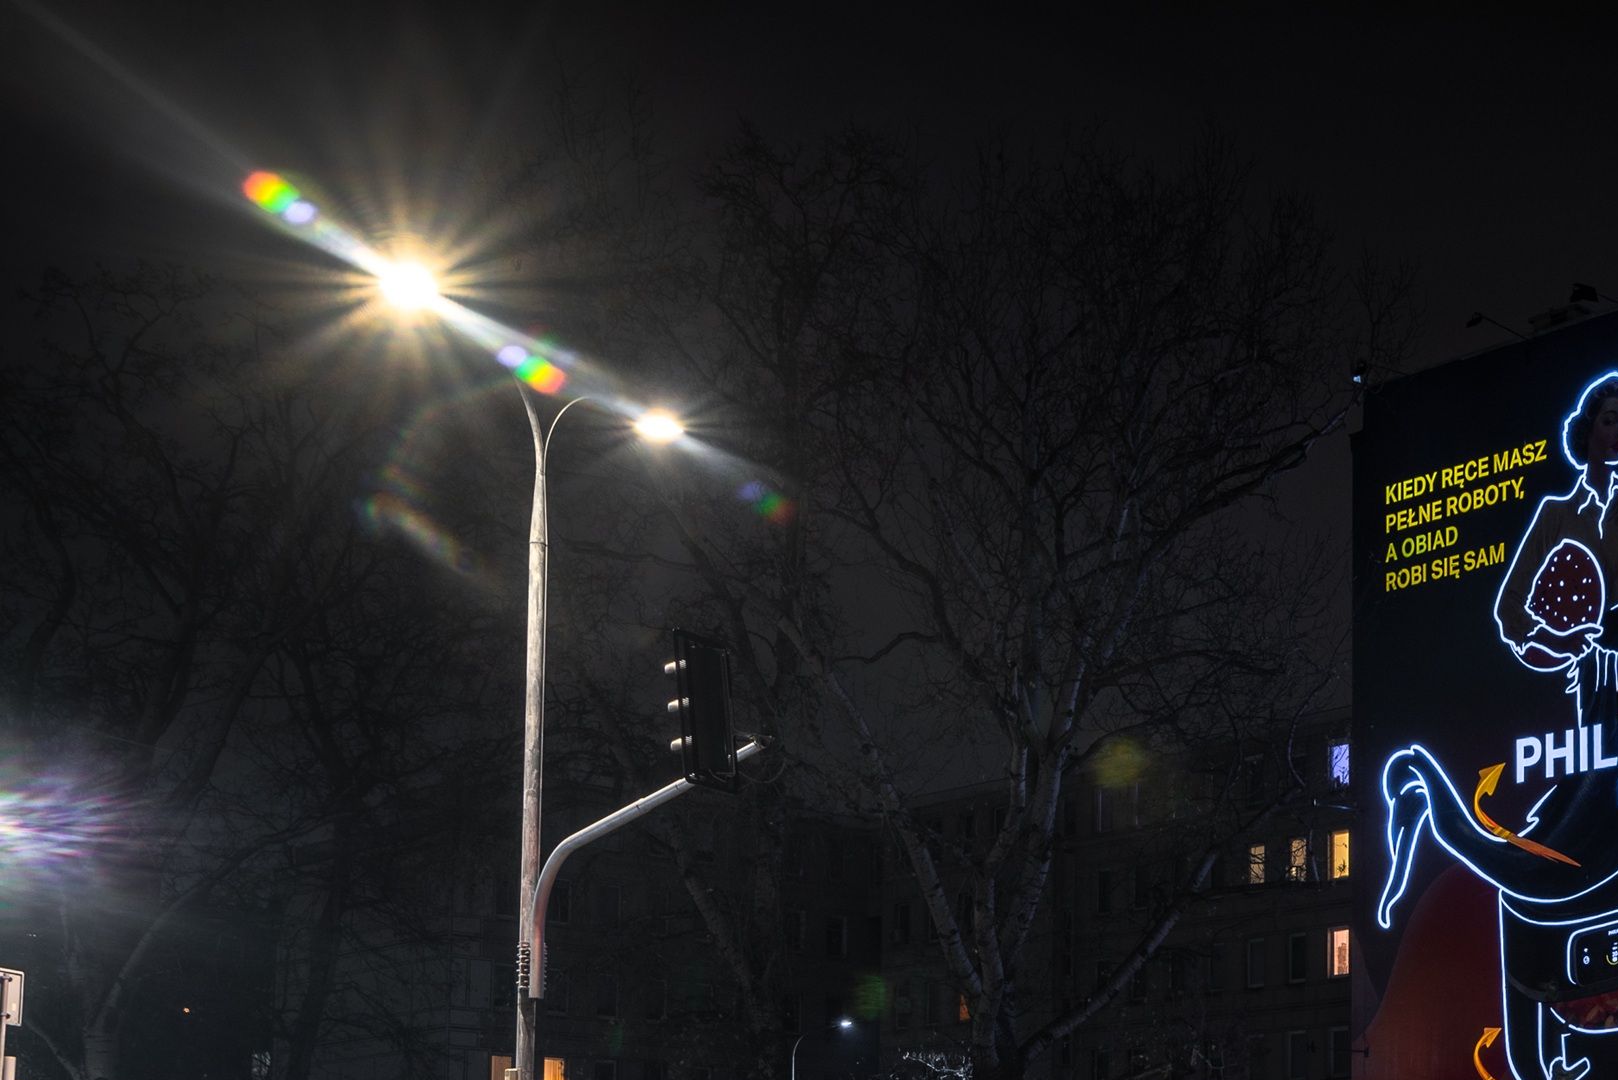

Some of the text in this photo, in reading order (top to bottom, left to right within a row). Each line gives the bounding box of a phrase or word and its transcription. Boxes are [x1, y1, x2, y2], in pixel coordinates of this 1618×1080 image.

[1385, 439, 1548, 505] KIEDY RĘCE MASZ
[1385, 476, 1526, 534] PEŁNE ROBOTY,
[1385, 525, 1459, 564] A OBIAD
[1385, 542, 1506, 593] ROBI SIĘ SAM
